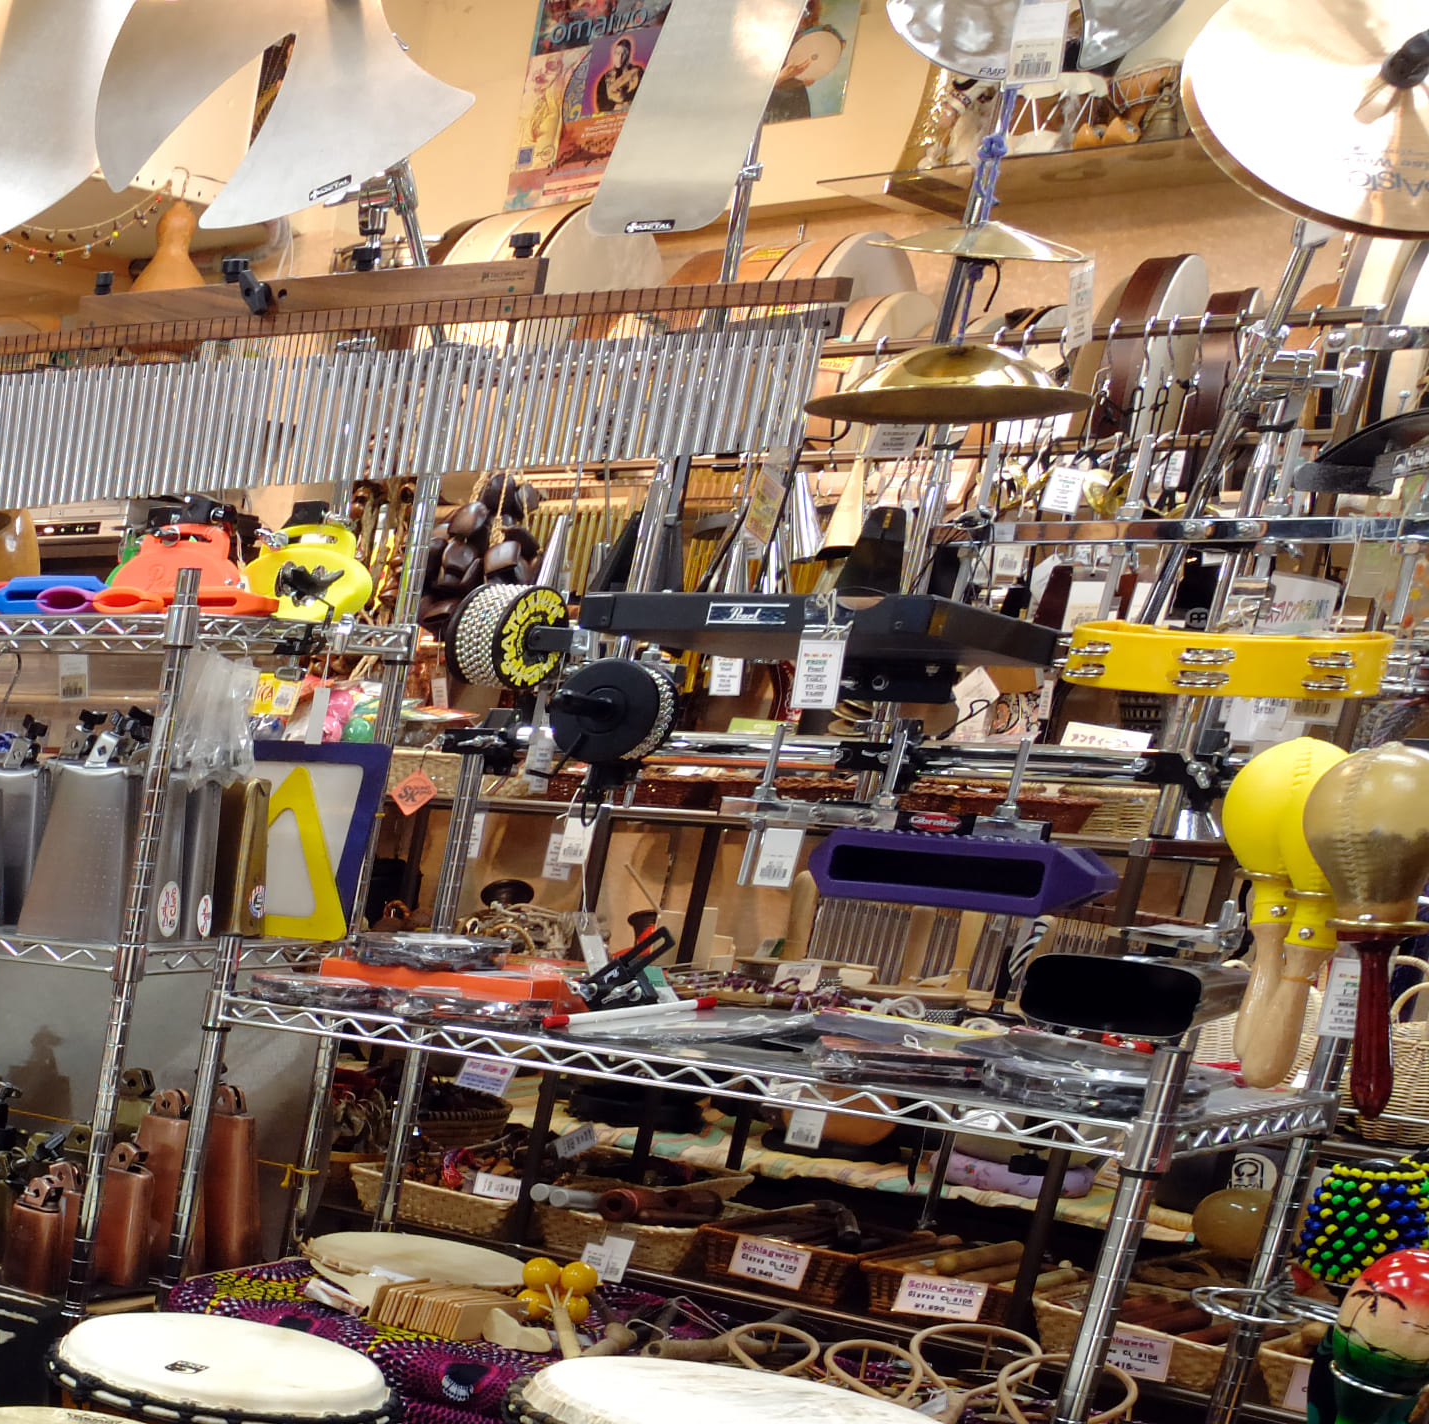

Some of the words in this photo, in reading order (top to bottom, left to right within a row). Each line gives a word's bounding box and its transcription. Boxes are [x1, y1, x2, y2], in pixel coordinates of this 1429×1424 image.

[549, 7, 648, 44] omaiyo
[978, 67, 1006, 76] FMP
[724, 606, 762, 621] Pearl
[910, 814, 961, 829] Gibraltar
